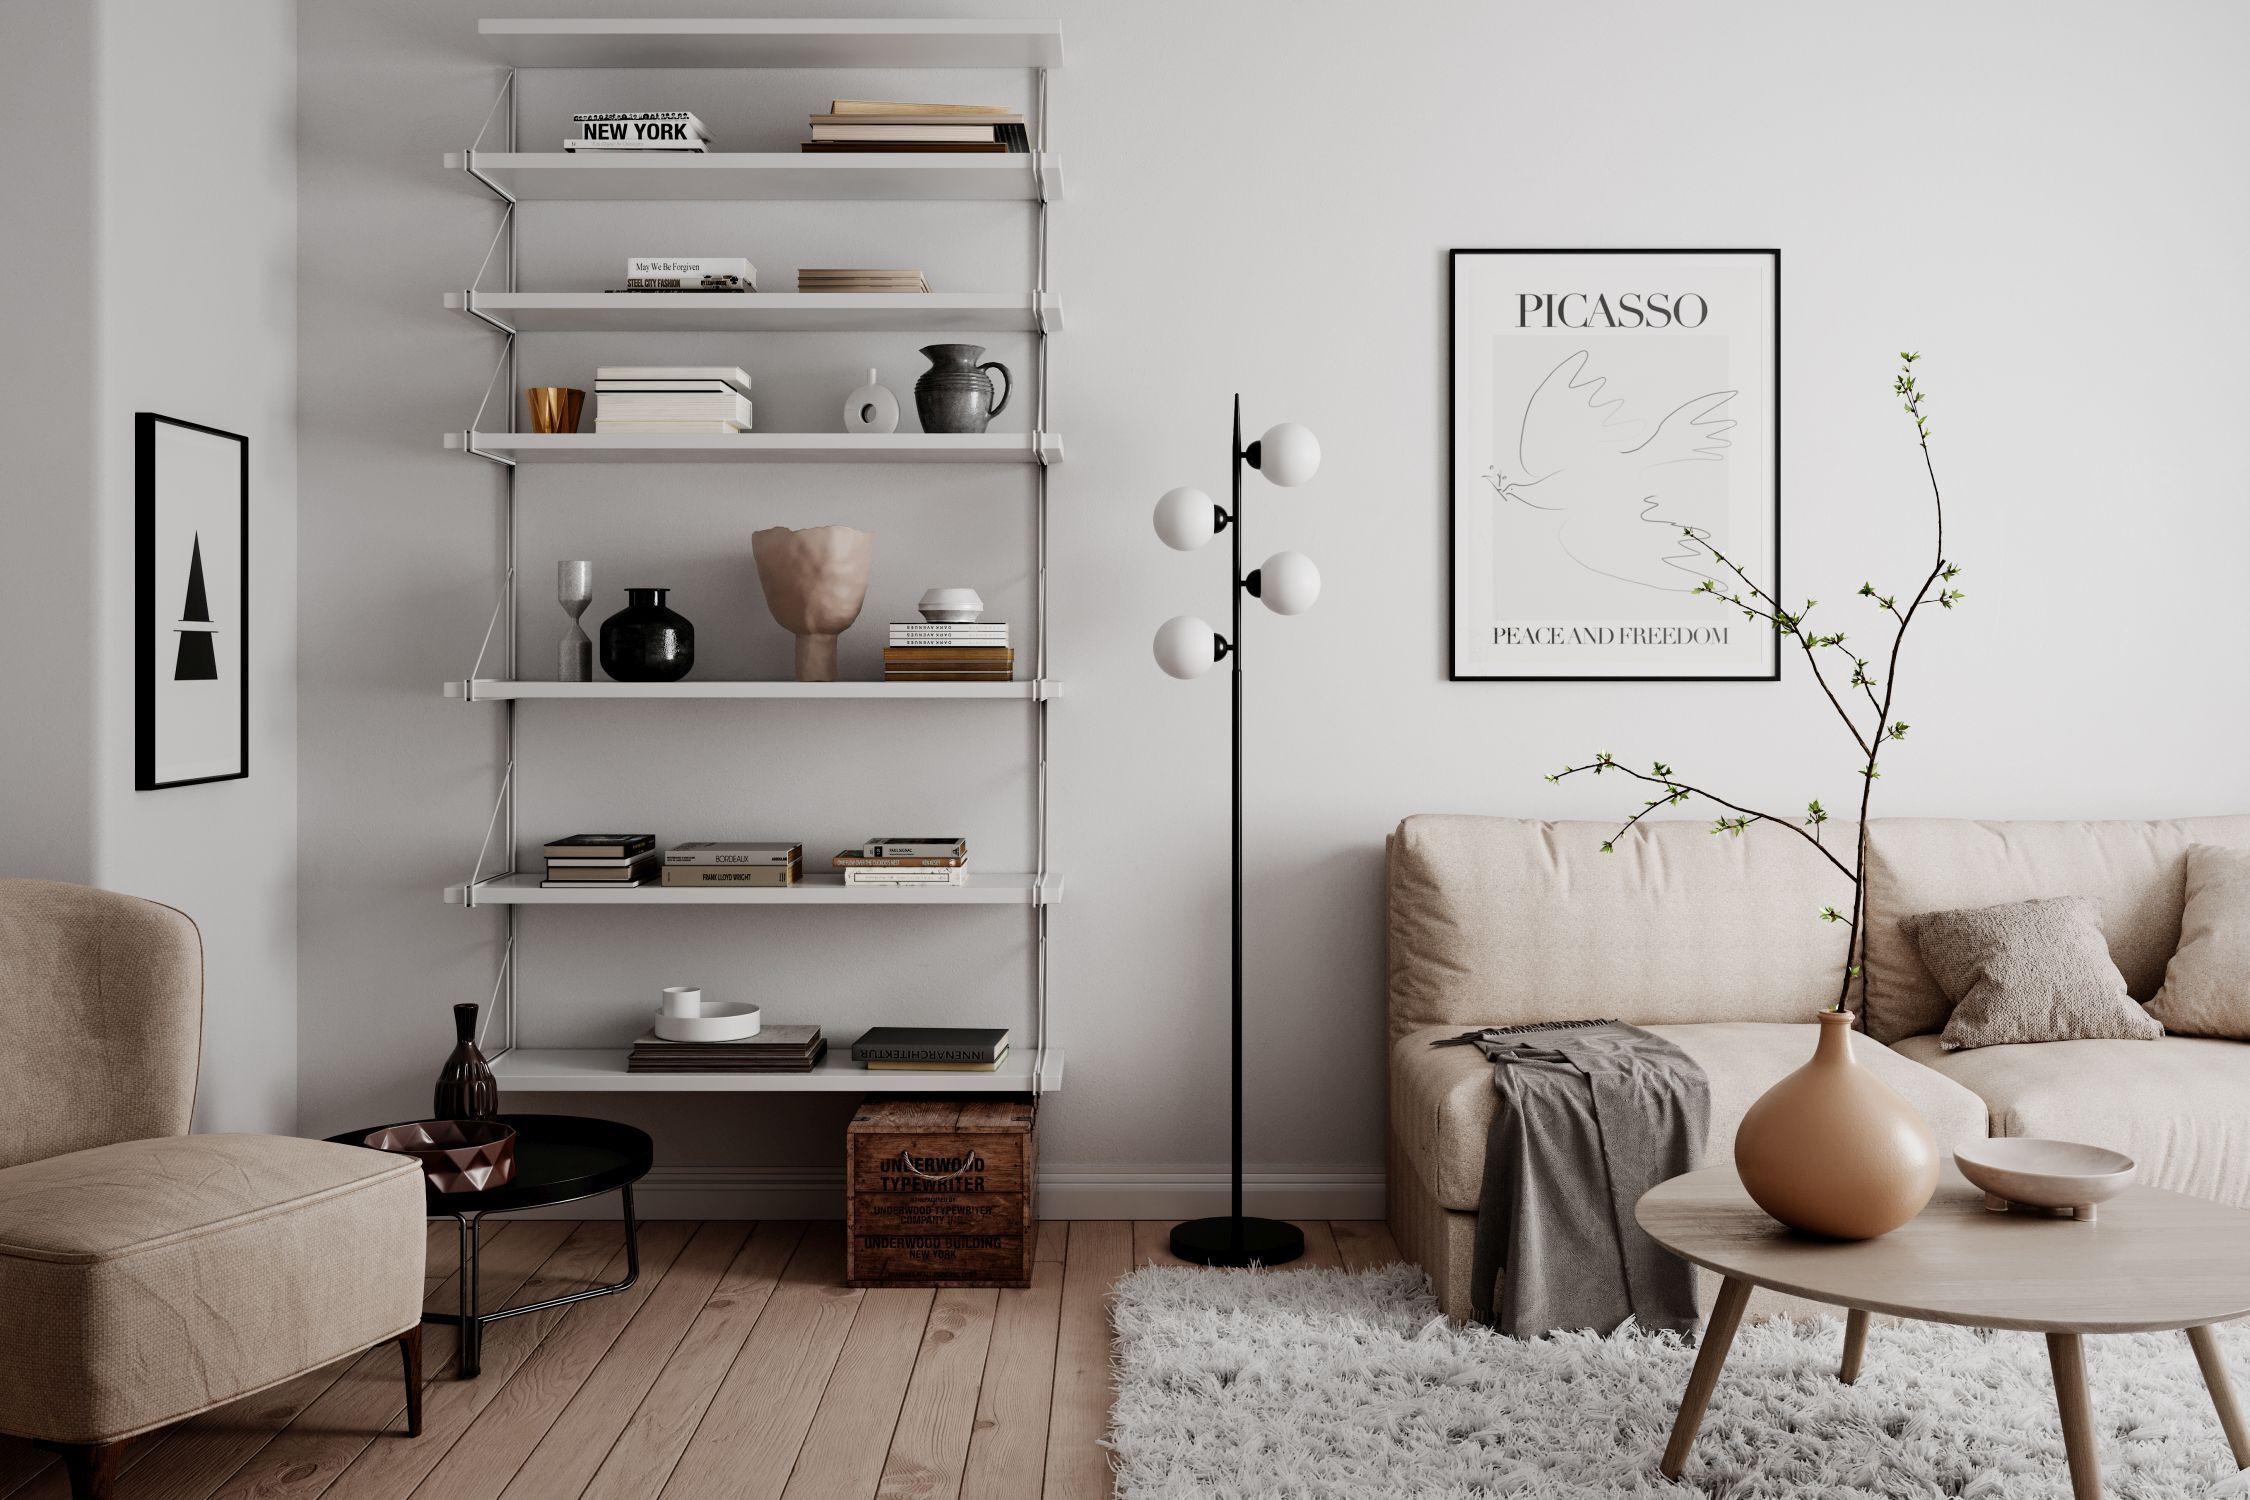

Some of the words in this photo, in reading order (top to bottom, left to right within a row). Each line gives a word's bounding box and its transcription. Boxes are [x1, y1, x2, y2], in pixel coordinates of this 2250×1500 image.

[584, 123, 628, 140] NEW
[634, 123, 688, 140] YORK
[636, 262, 649, 273] May
[651, 262, 662, 271] We
[663, 262, 672, 271] Be
[672, 262, 700, 273] Forgiven
[627, 278, 644, 288] STEEL
[644, 278, 657, 288] CITY
[657, 278, 681, 288] FASHION
[1515, 293, 1708, 328] PICASSO
[1492, 627, 1565, 645] PEACE
[1567, 627, 1615, 645] AND
[1619, 627, 1729, 645] FREEDOM
[715, 855, 749, 863] BORDEAUX
[702, 873, 717, 881] FRANK
[718, 873, 732, 881] LLOYD
[733, 873, 751, 881] WRIGHT
[860, 1050, 985, 1060] INNENARCHITEKTUR
[880, 1176, 985, 1191] TYPEWRITER
[874, 1206, 932, 1215] UNDERWOOD
[900, 1215, 944, 1225] COMPANY
[909, 1250, 929, 1259] NEW
[932, 1250, 956, 1259] YORK
